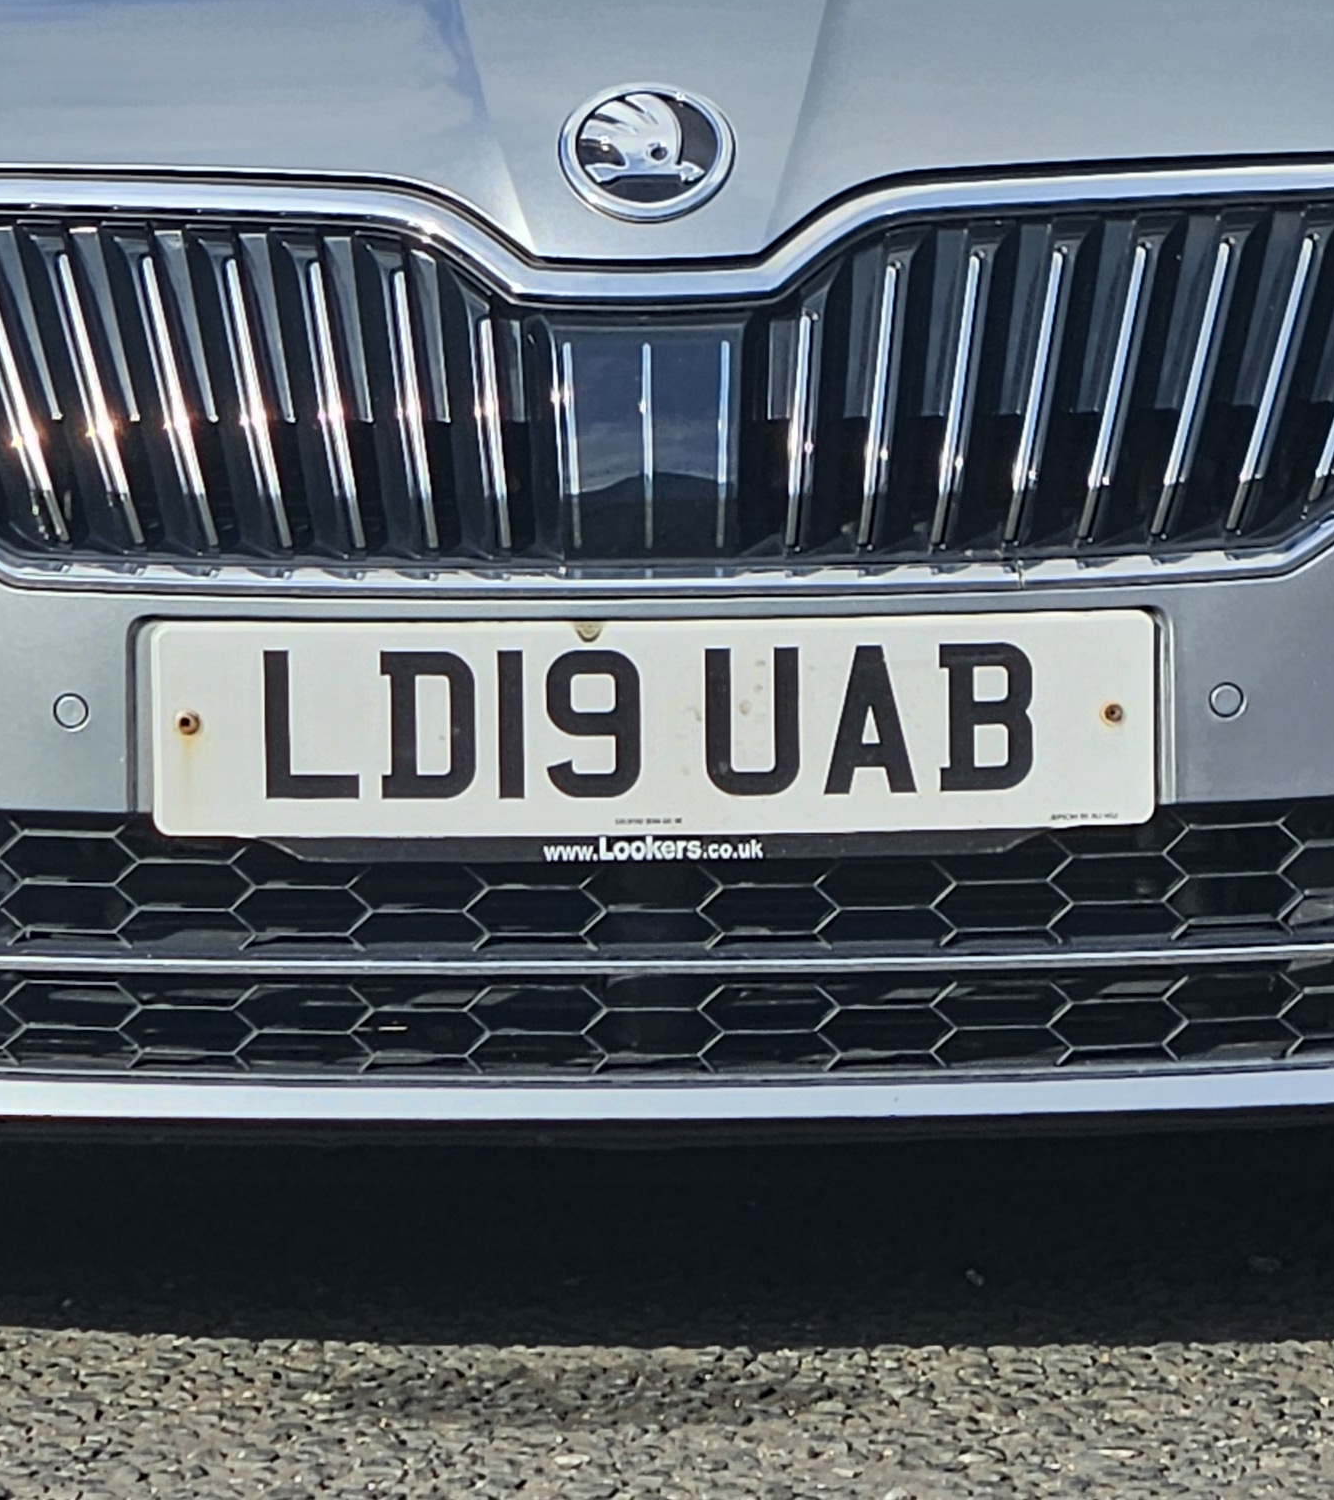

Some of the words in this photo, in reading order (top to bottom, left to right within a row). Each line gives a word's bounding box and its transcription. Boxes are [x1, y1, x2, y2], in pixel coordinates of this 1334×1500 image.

[262, 649, 642, 800] LD19
[703, 641, 1035, 796] UAB
[543, 835, 764, 862] www.Lookers.co.uk
